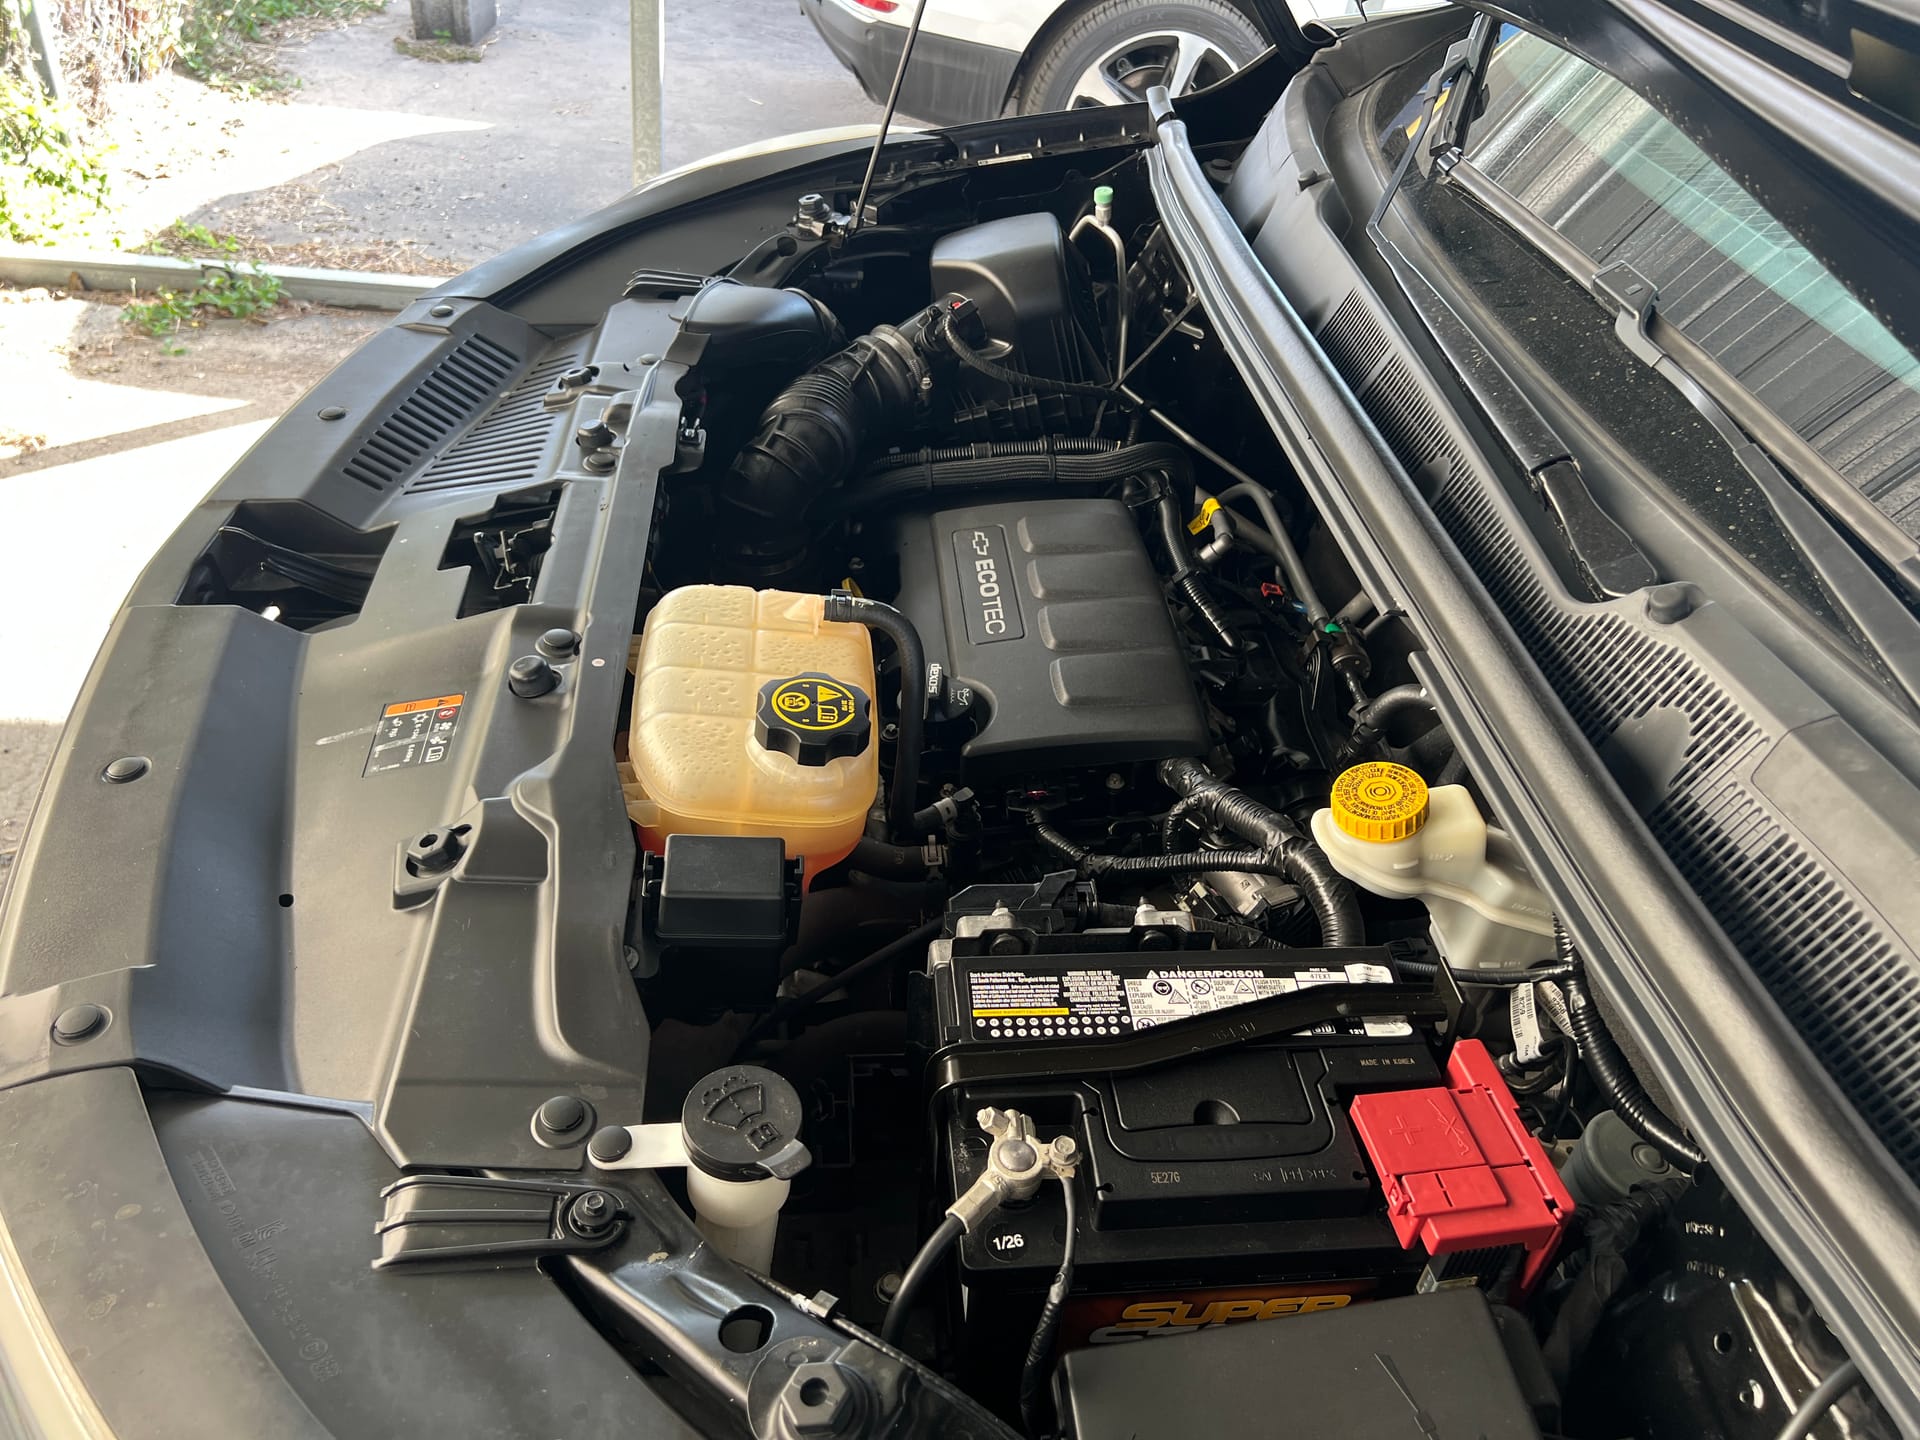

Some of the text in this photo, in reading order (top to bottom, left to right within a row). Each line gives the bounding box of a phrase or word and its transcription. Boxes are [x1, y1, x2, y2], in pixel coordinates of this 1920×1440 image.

[975, 559, 1006, 635] ECOTEC
[929, 663, 942, 695] dexos
[1159, 970, 1264, 978] DANGER/POISON
[1360, 1058, 1379, 1066] MADE
[1392, 1057, 1416, 1065] KOREA
[992, 1233, 1024, 1251] 1/26
